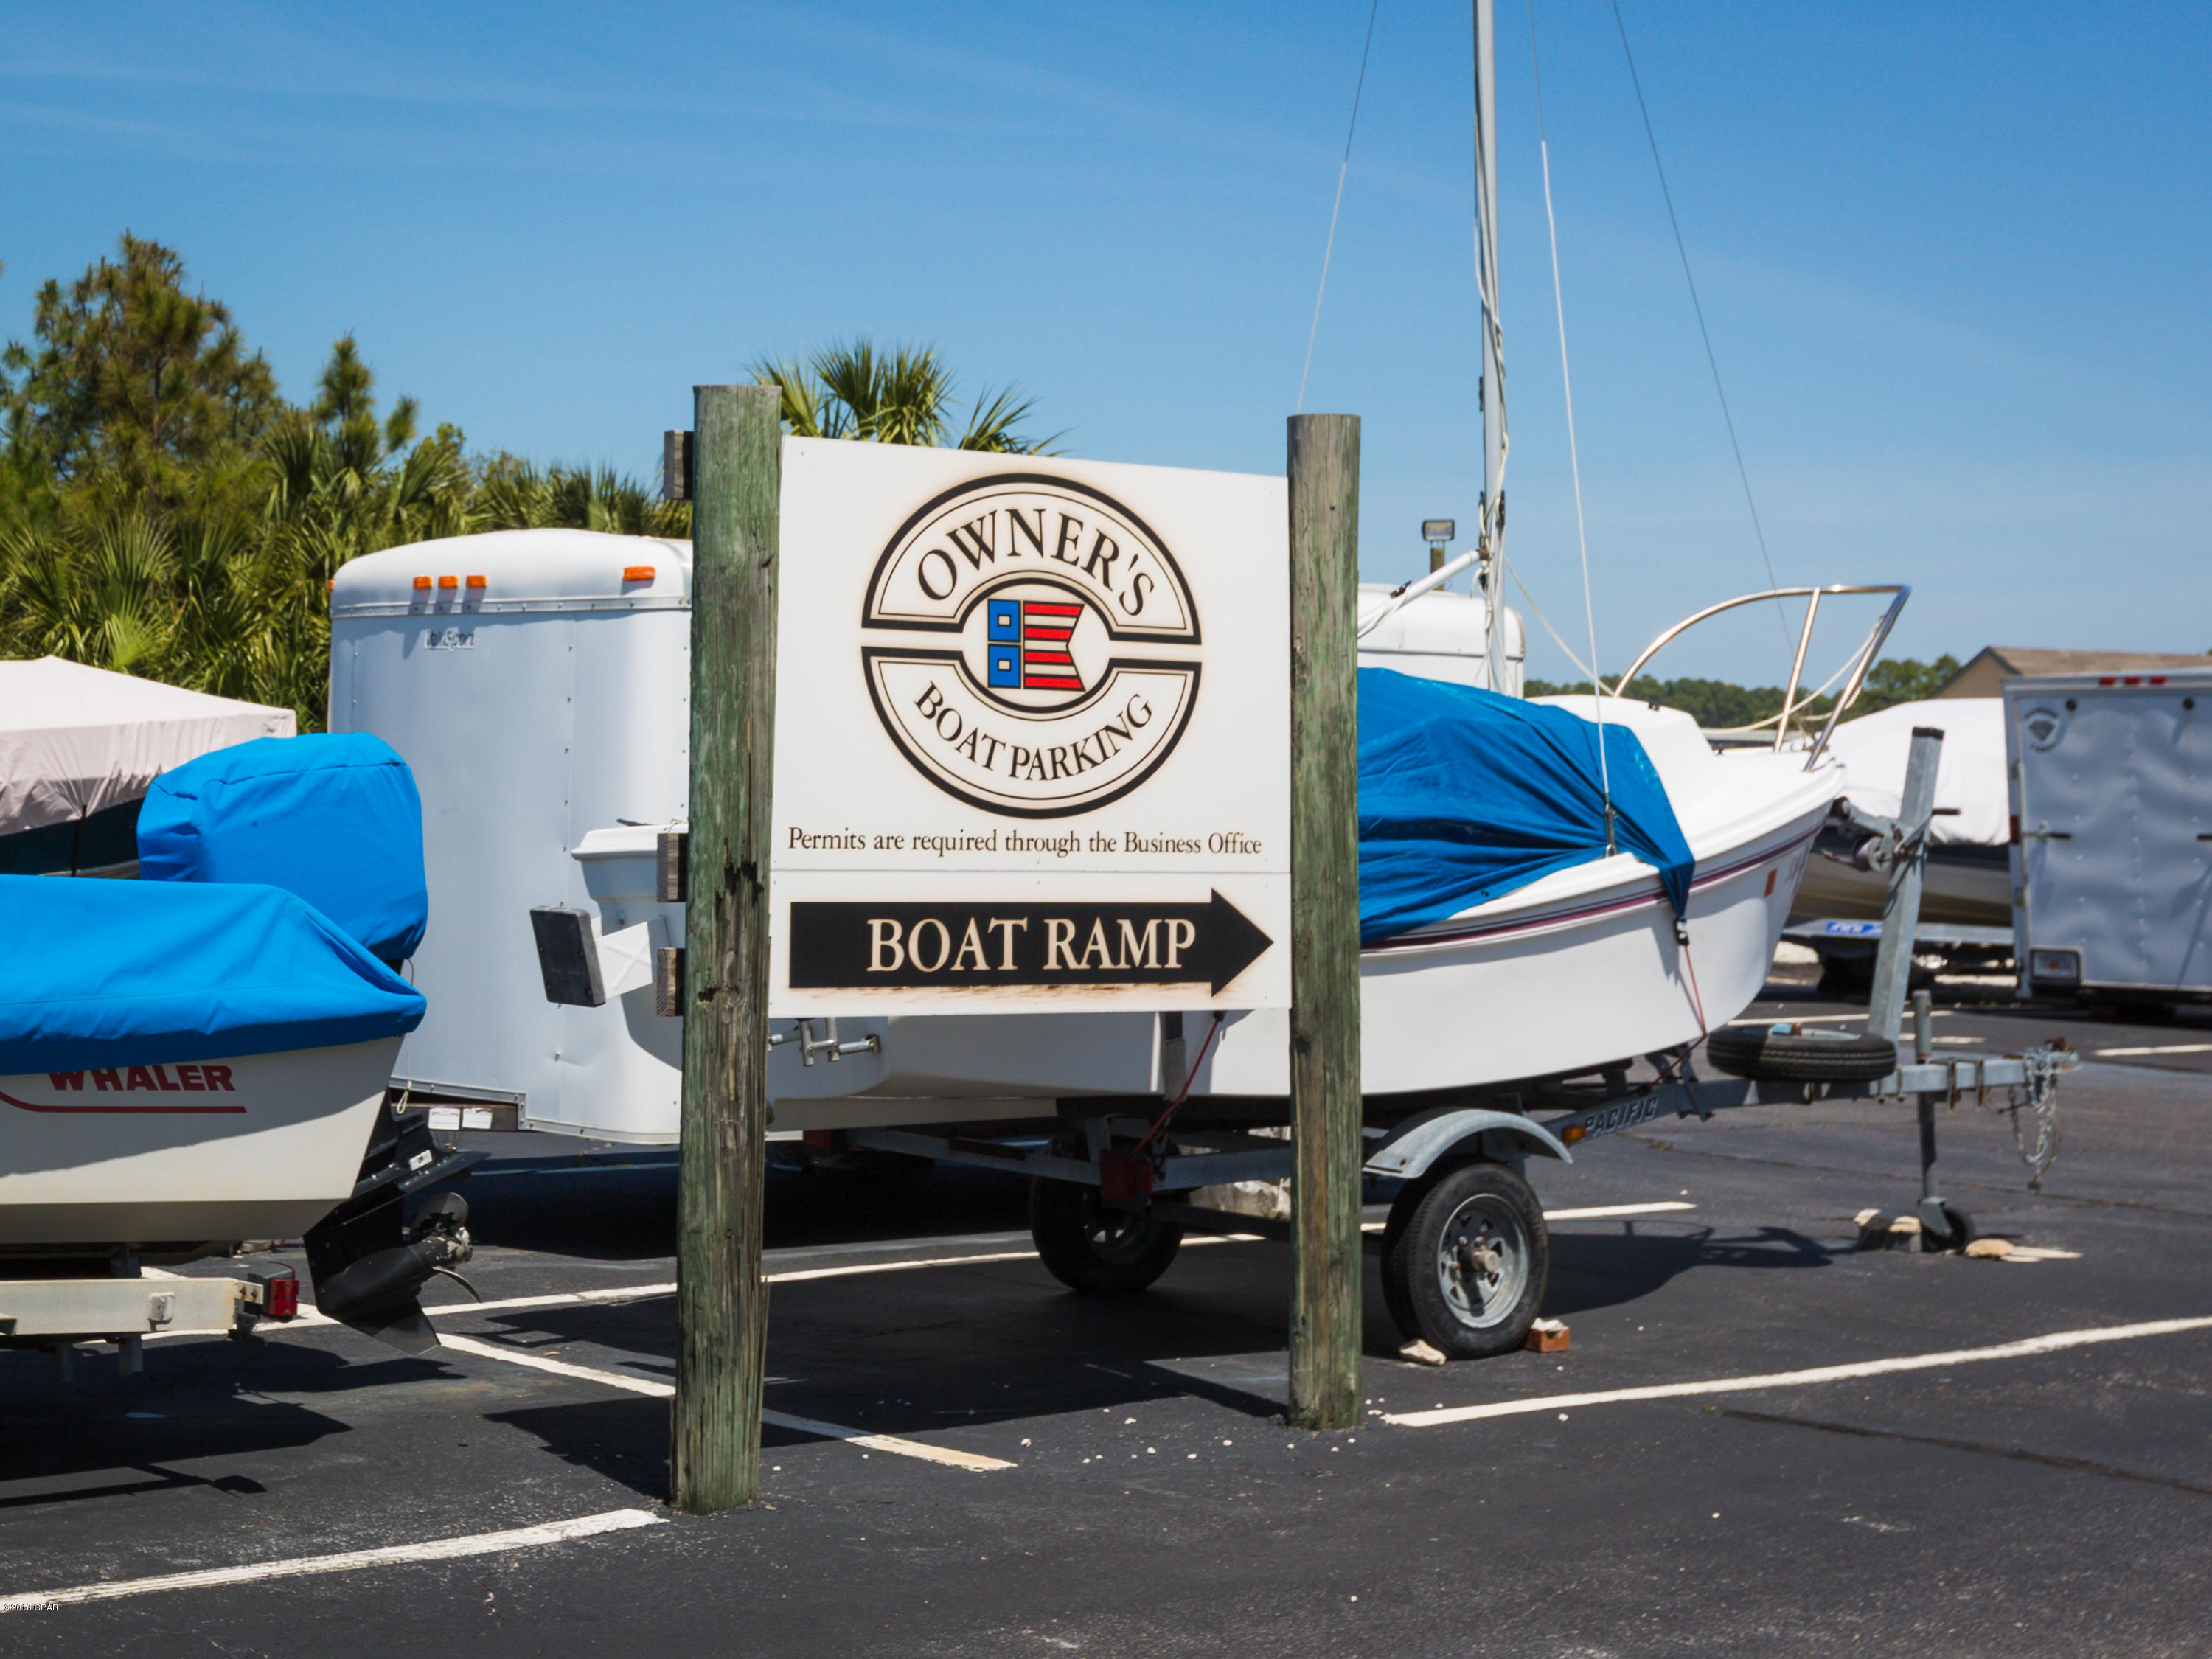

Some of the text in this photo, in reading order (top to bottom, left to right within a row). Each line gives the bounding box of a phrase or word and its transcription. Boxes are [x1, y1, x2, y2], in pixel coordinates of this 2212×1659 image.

[918, 508, 1155, 616] OWNER'S
[914, 681, 1152, 782] BOAT PARKING
[788, 827, 1262, 858] Permits are required through the Business Office
[866, 916, 1196, 973] BOAT RAMP
[47, 1065, 236, 1091] WHALER
[1585, 1096, 1659, 1138] PACIFIC
